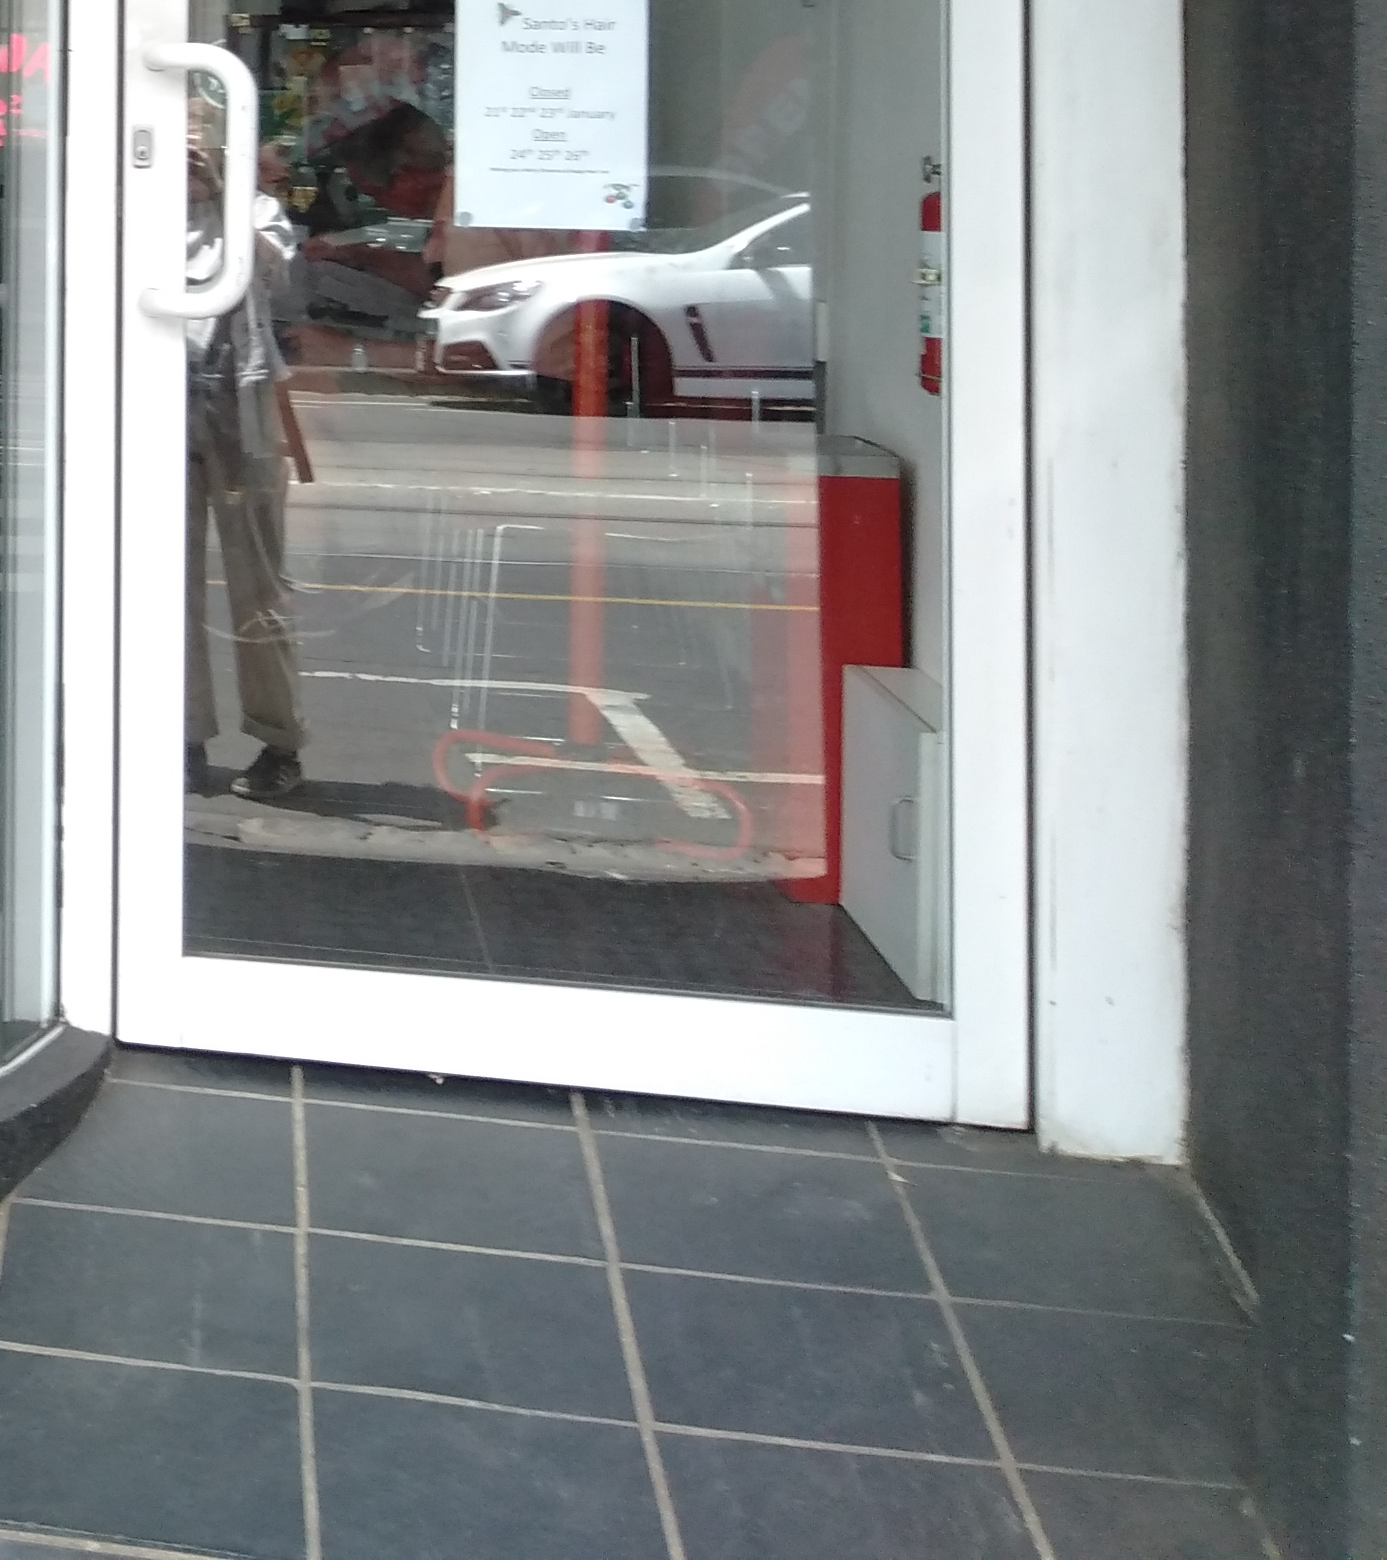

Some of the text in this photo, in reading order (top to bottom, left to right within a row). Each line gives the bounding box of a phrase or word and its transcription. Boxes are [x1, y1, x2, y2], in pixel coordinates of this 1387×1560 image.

[522, 17, 617, 30] Santo's Hair
[501, 41, 607, 54] Mode Will Be
[529, 86, 571, 99] Closed
[567, 110, 616, 121] January
[531, 129, 567, 142] Open
